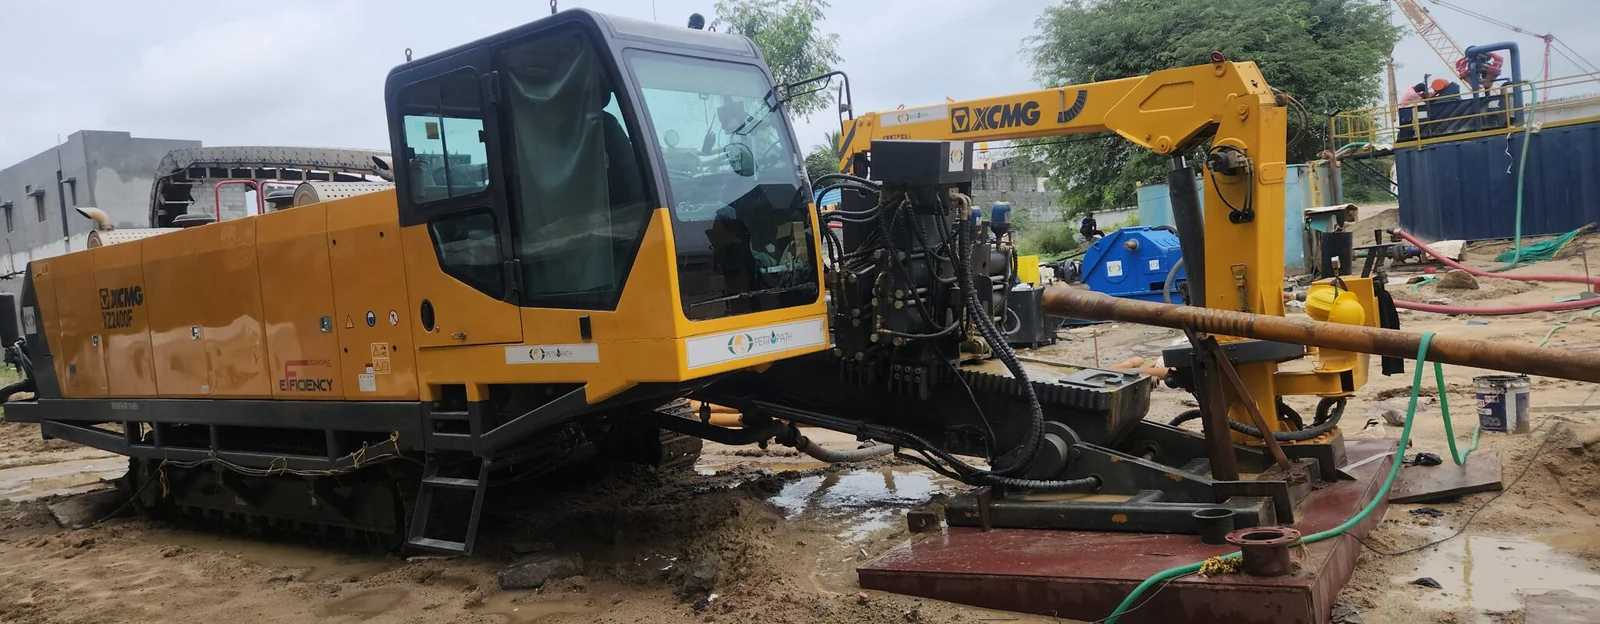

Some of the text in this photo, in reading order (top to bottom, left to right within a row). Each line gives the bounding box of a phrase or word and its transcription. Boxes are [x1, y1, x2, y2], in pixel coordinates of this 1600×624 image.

[971, 101, 1041, 131] XCMG
[110, 286, 144, 309] XCMG
[102, 309, 133, 329] XZ2400F
